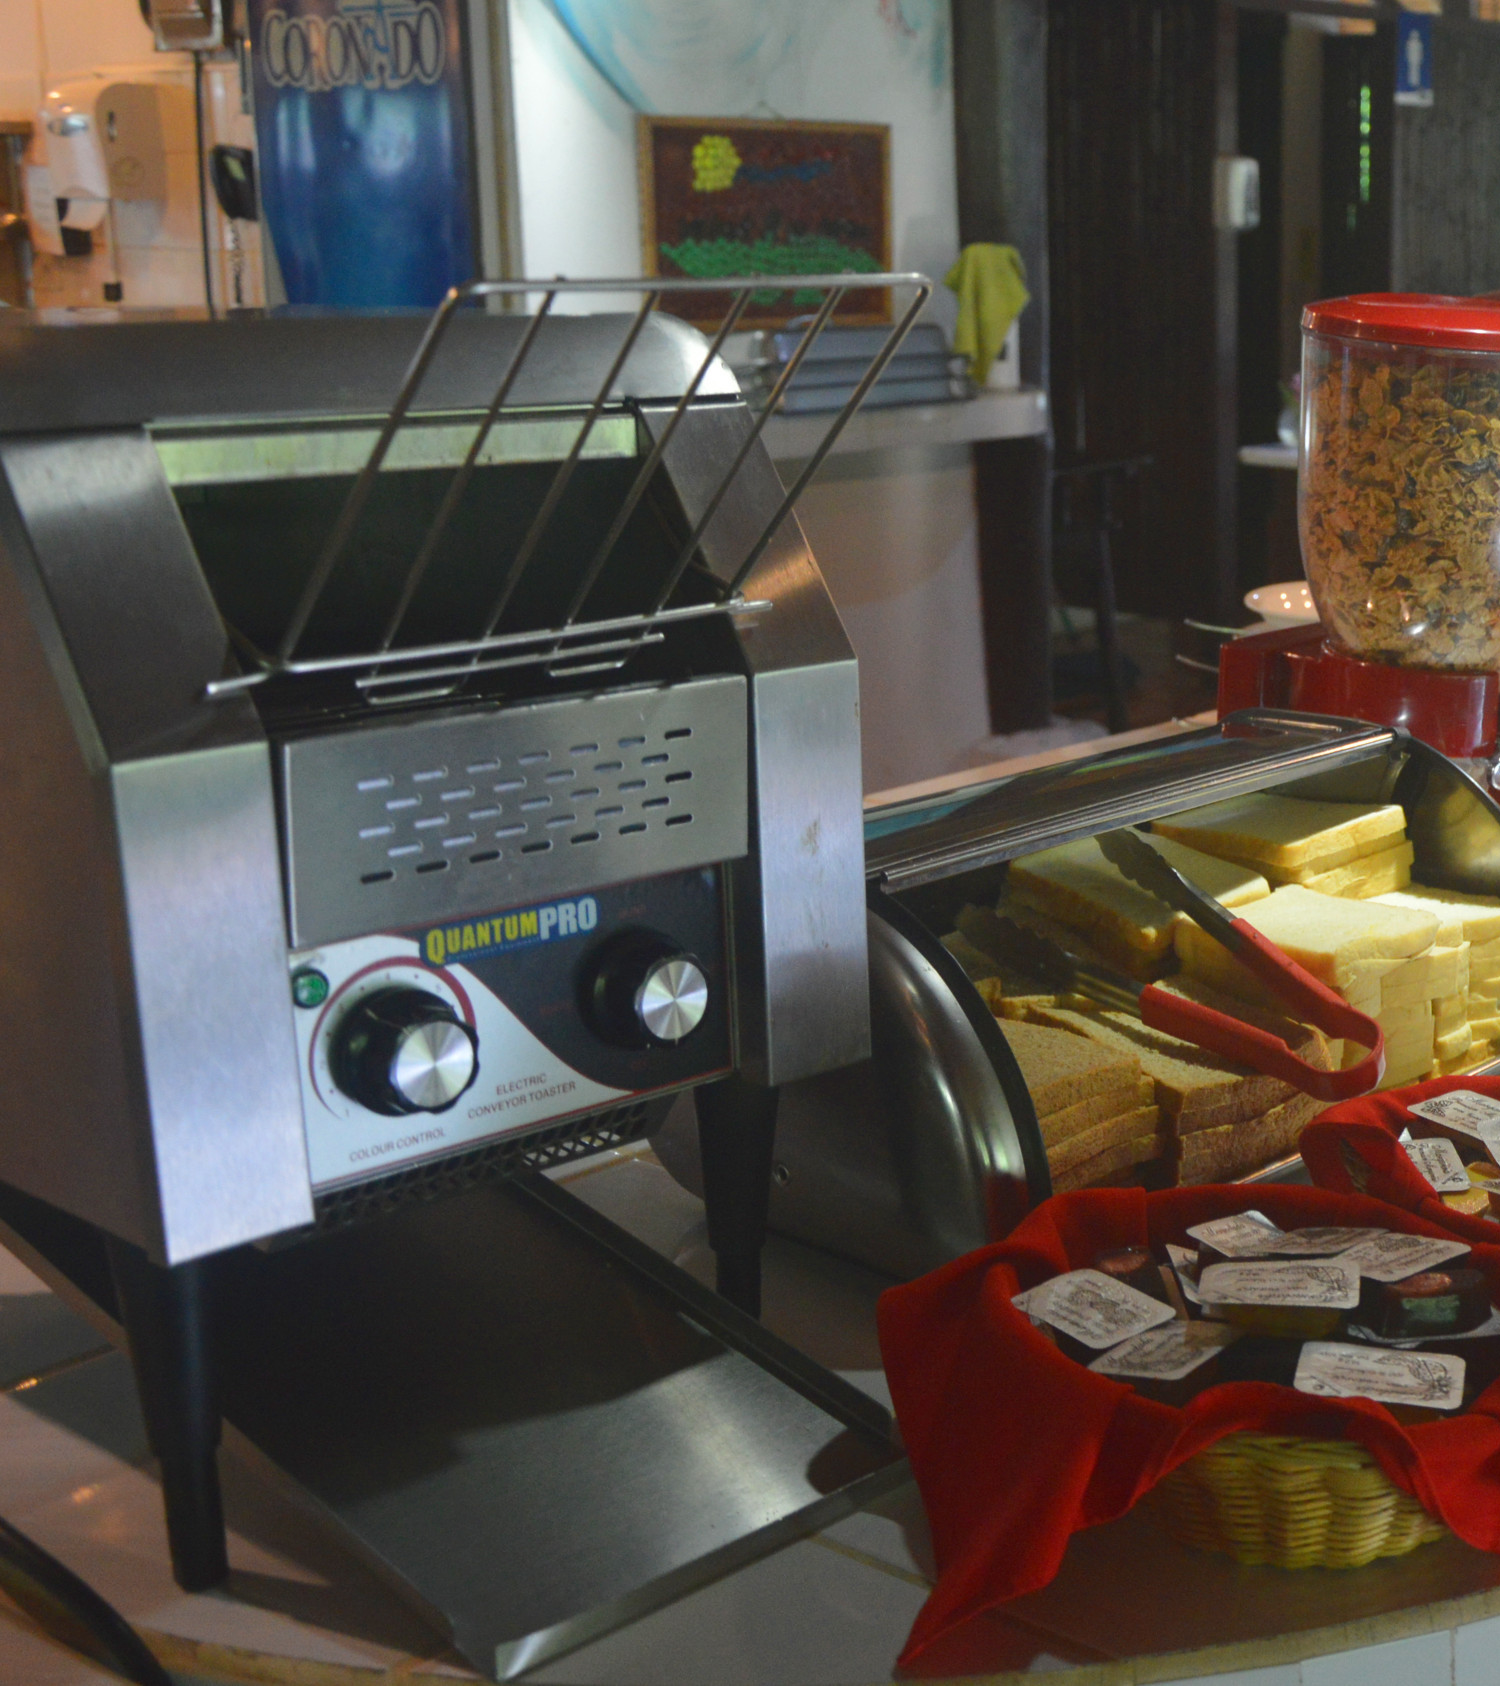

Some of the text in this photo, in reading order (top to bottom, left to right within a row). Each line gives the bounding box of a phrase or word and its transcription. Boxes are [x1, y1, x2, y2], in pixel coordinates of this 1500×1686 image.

[263, 3, 446, 91] CORONADO
[467, 1081, 576, 1119] CONVEYOR TOASTER
[496, 1073, 548, 1096] ELECTRIC
[349, 1126, 445, 1163] COLOUR CONTROL
